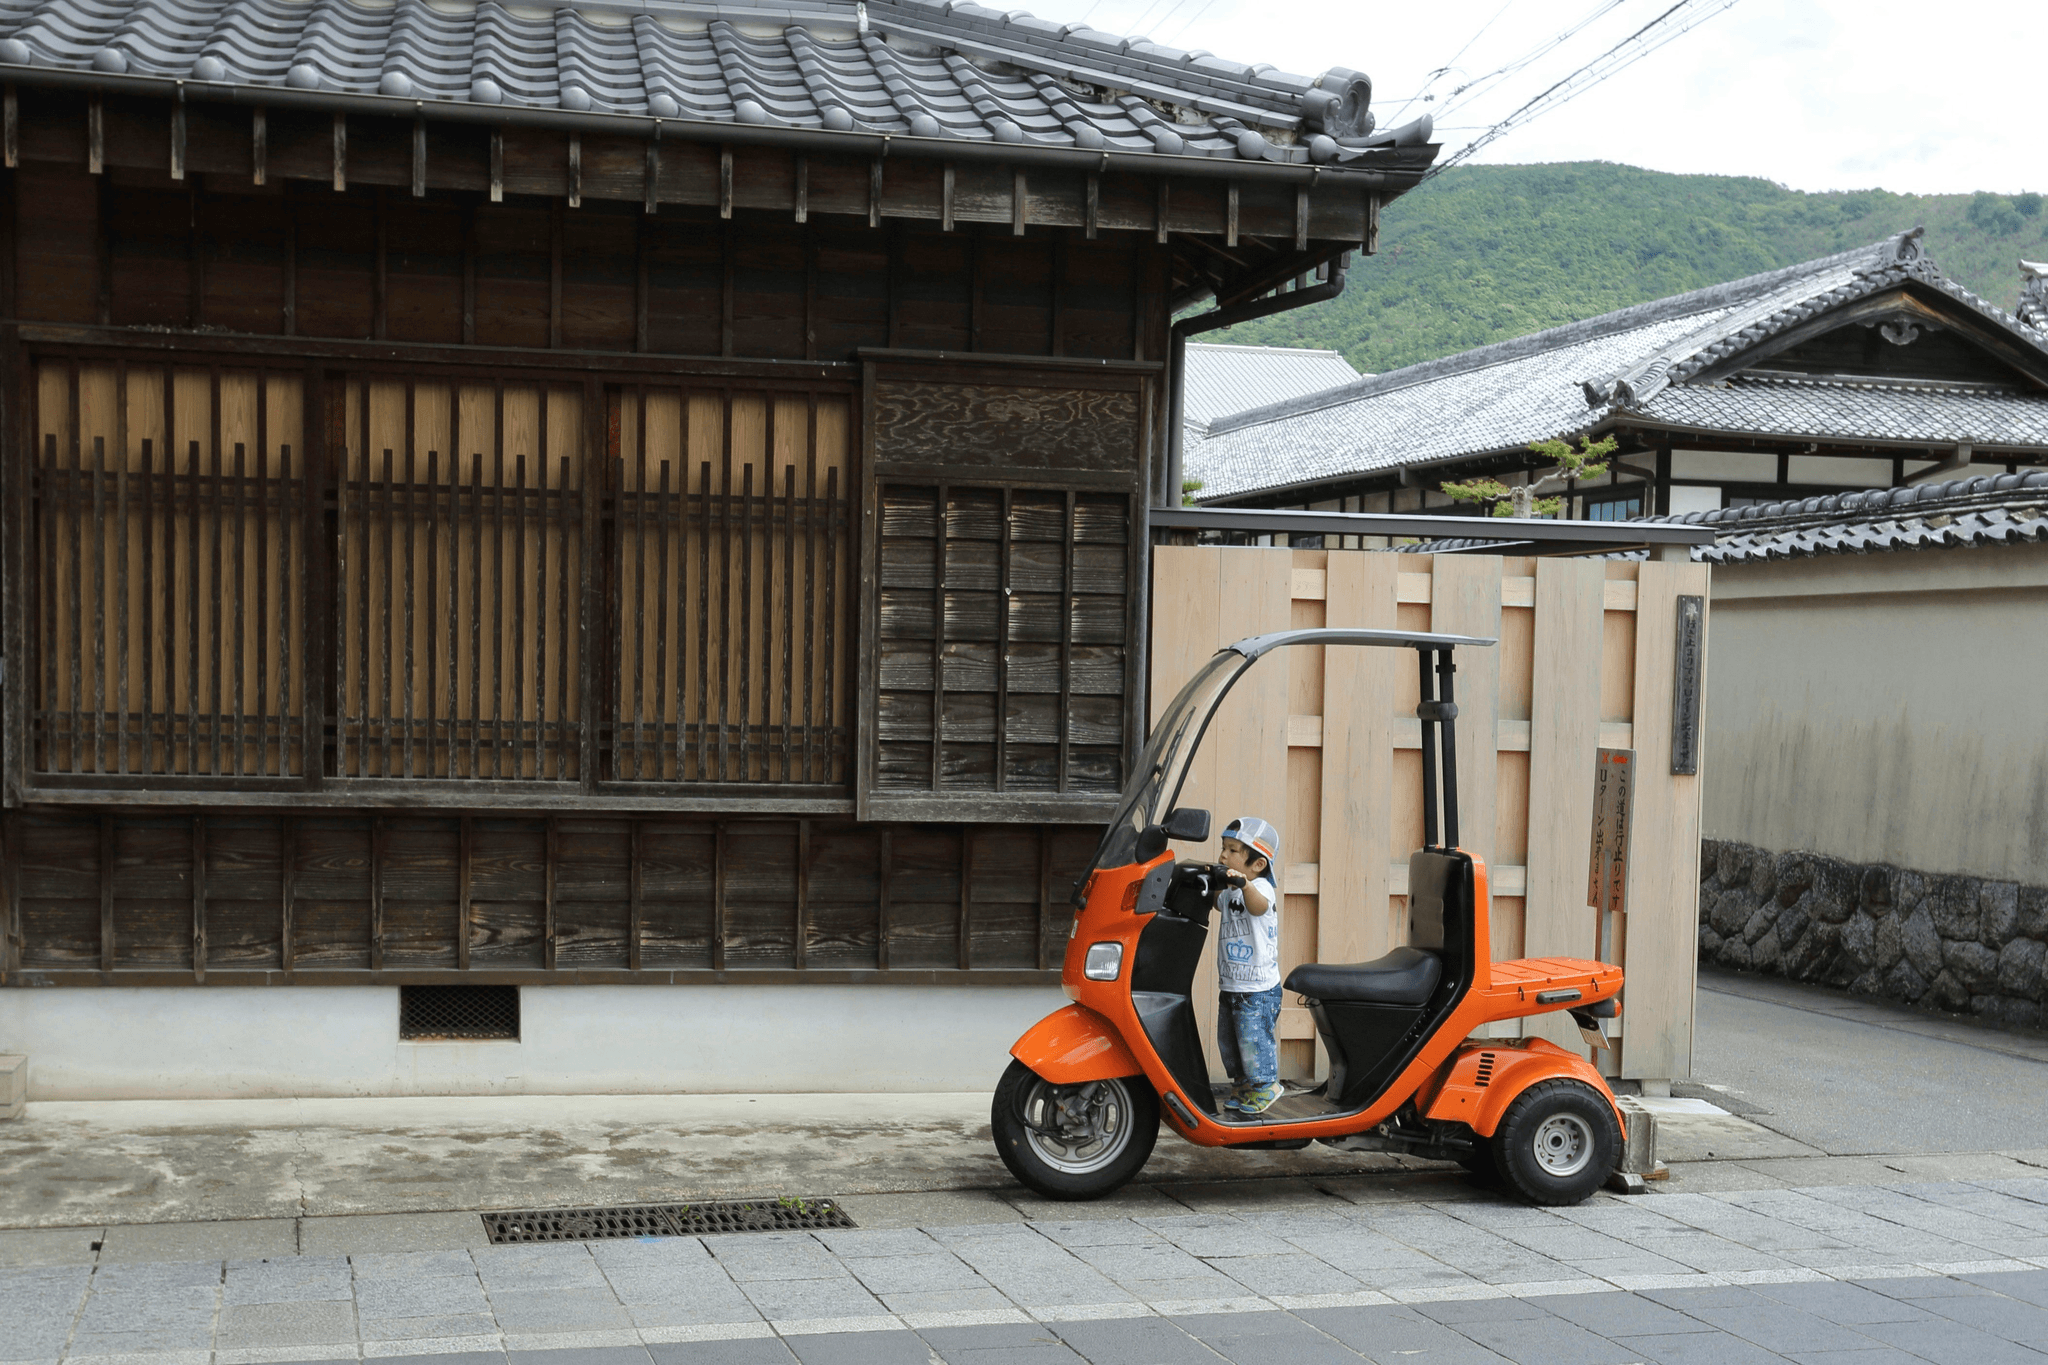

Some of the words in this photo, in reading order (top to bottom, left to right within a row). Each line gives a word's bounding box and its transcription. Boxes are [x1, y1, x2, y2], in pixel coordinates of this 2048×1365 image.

[1612, 770, 1626, 909] この道は行止りです
